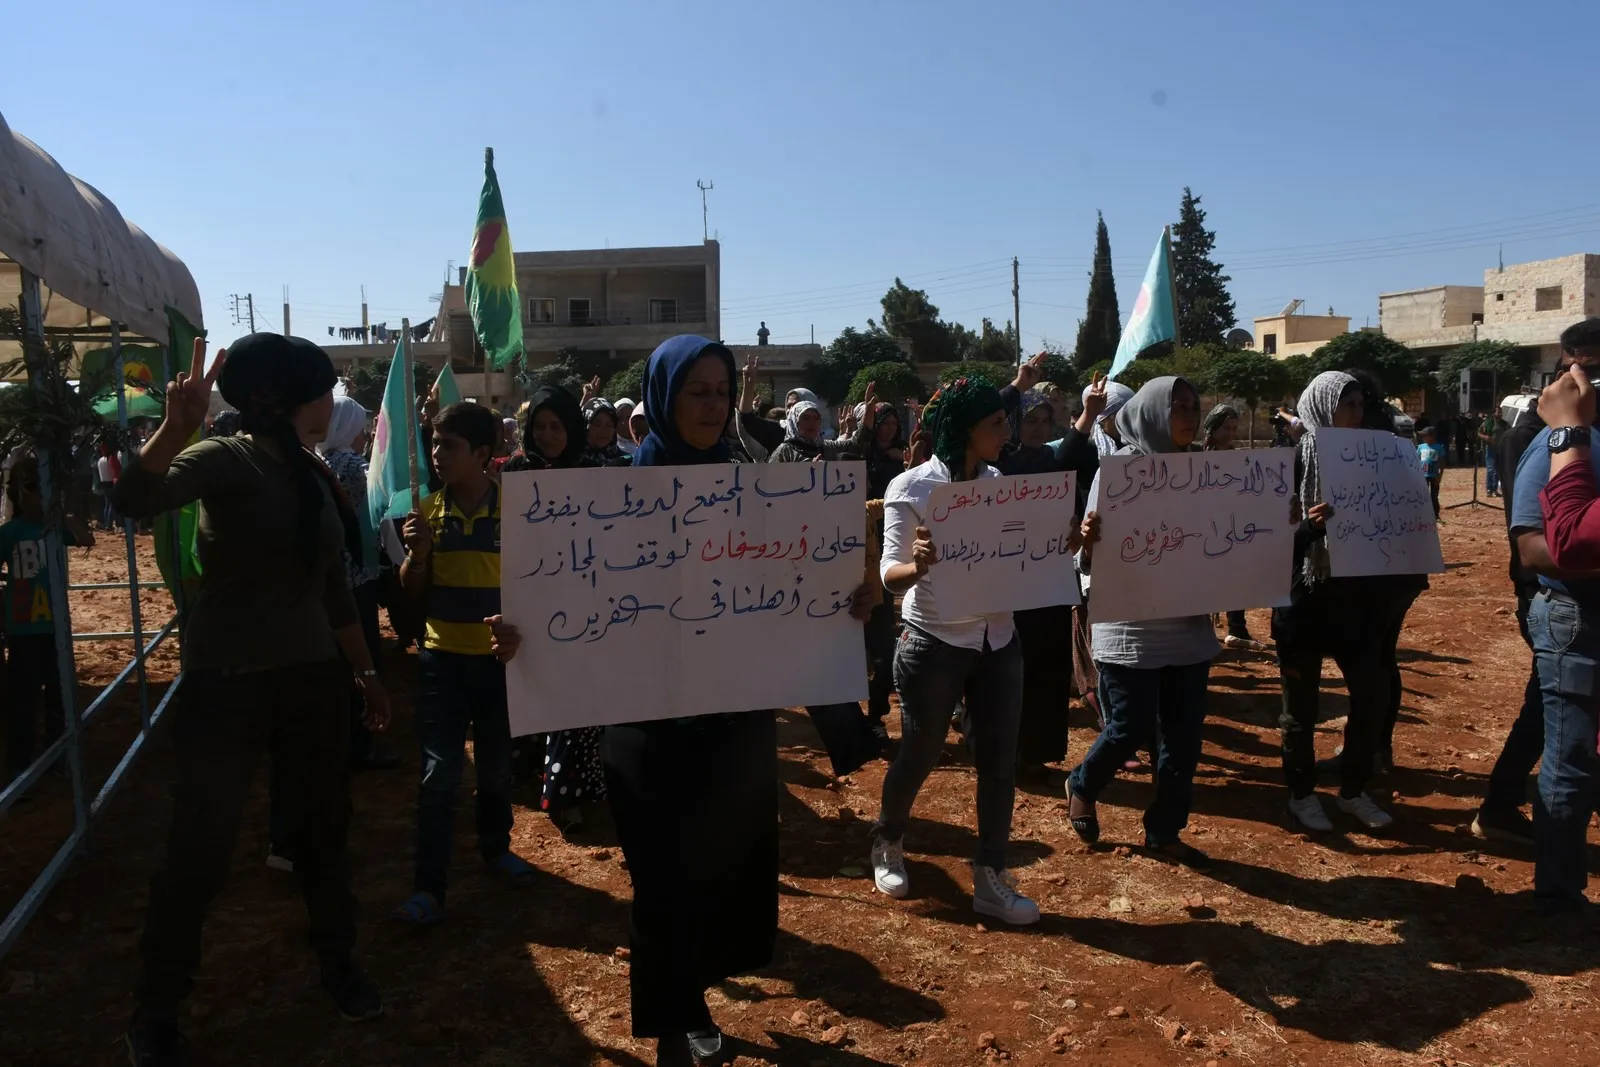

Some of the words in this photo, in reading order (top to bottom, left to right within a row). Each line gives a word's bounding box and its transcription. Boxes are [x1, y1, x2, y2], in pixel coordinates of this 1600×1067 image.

[683, 465, 744, 525] المجتمع
[754, 461, 855, 508] نطالب
[1265, 461, 1288, 497] لا
[520, 481, 580, 526] بضغط
[588, 477, 684, 534] الدولي
[604, 538, 692, 571] لوقف
[701, 524, 808, 562] أردوغان
[812, 525, 865, 563] على
[1120, 521, 1203, 565] عفرين
[1203, 512, 1274, 557] على
[519, 537, 597, 589] المجازر
[669, 578, 727, 635] في
[733, 574, 804, 617] أهلنا
[548, 594, 665, 643] عفرين
